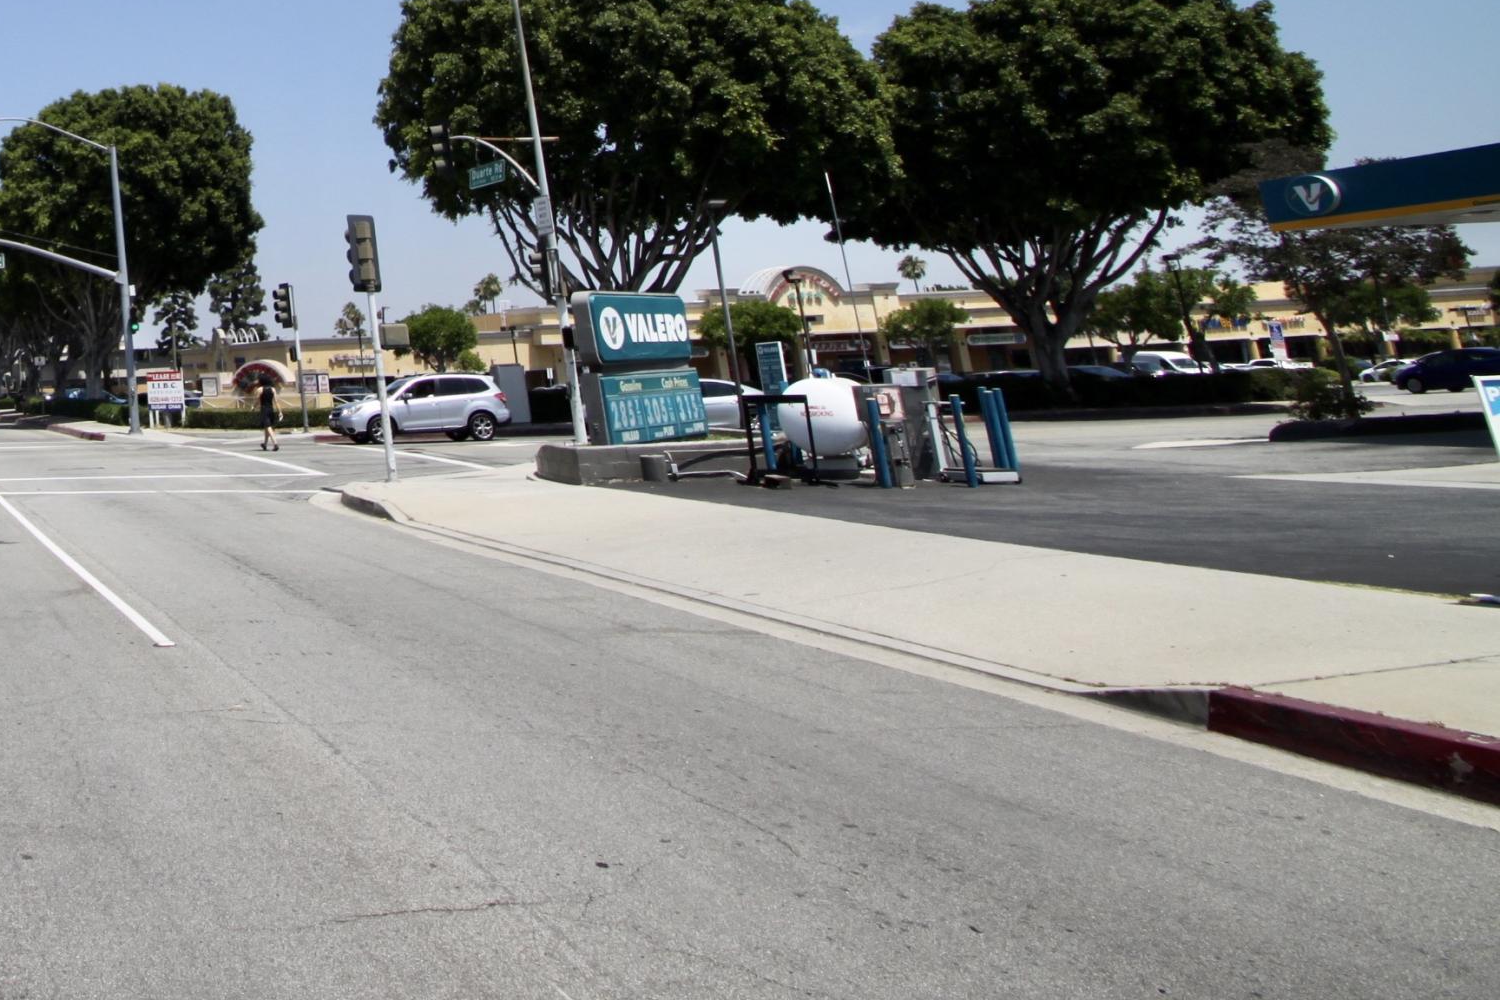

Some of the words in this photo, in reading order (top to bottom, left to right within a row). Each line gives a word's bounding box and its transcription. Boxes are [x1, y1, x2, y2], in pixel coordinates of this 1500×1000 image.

[472, 167, 493, 180] Duarte
[494, 163, 503, 174] Rd
[623, 312, 688, 343] VALERO
